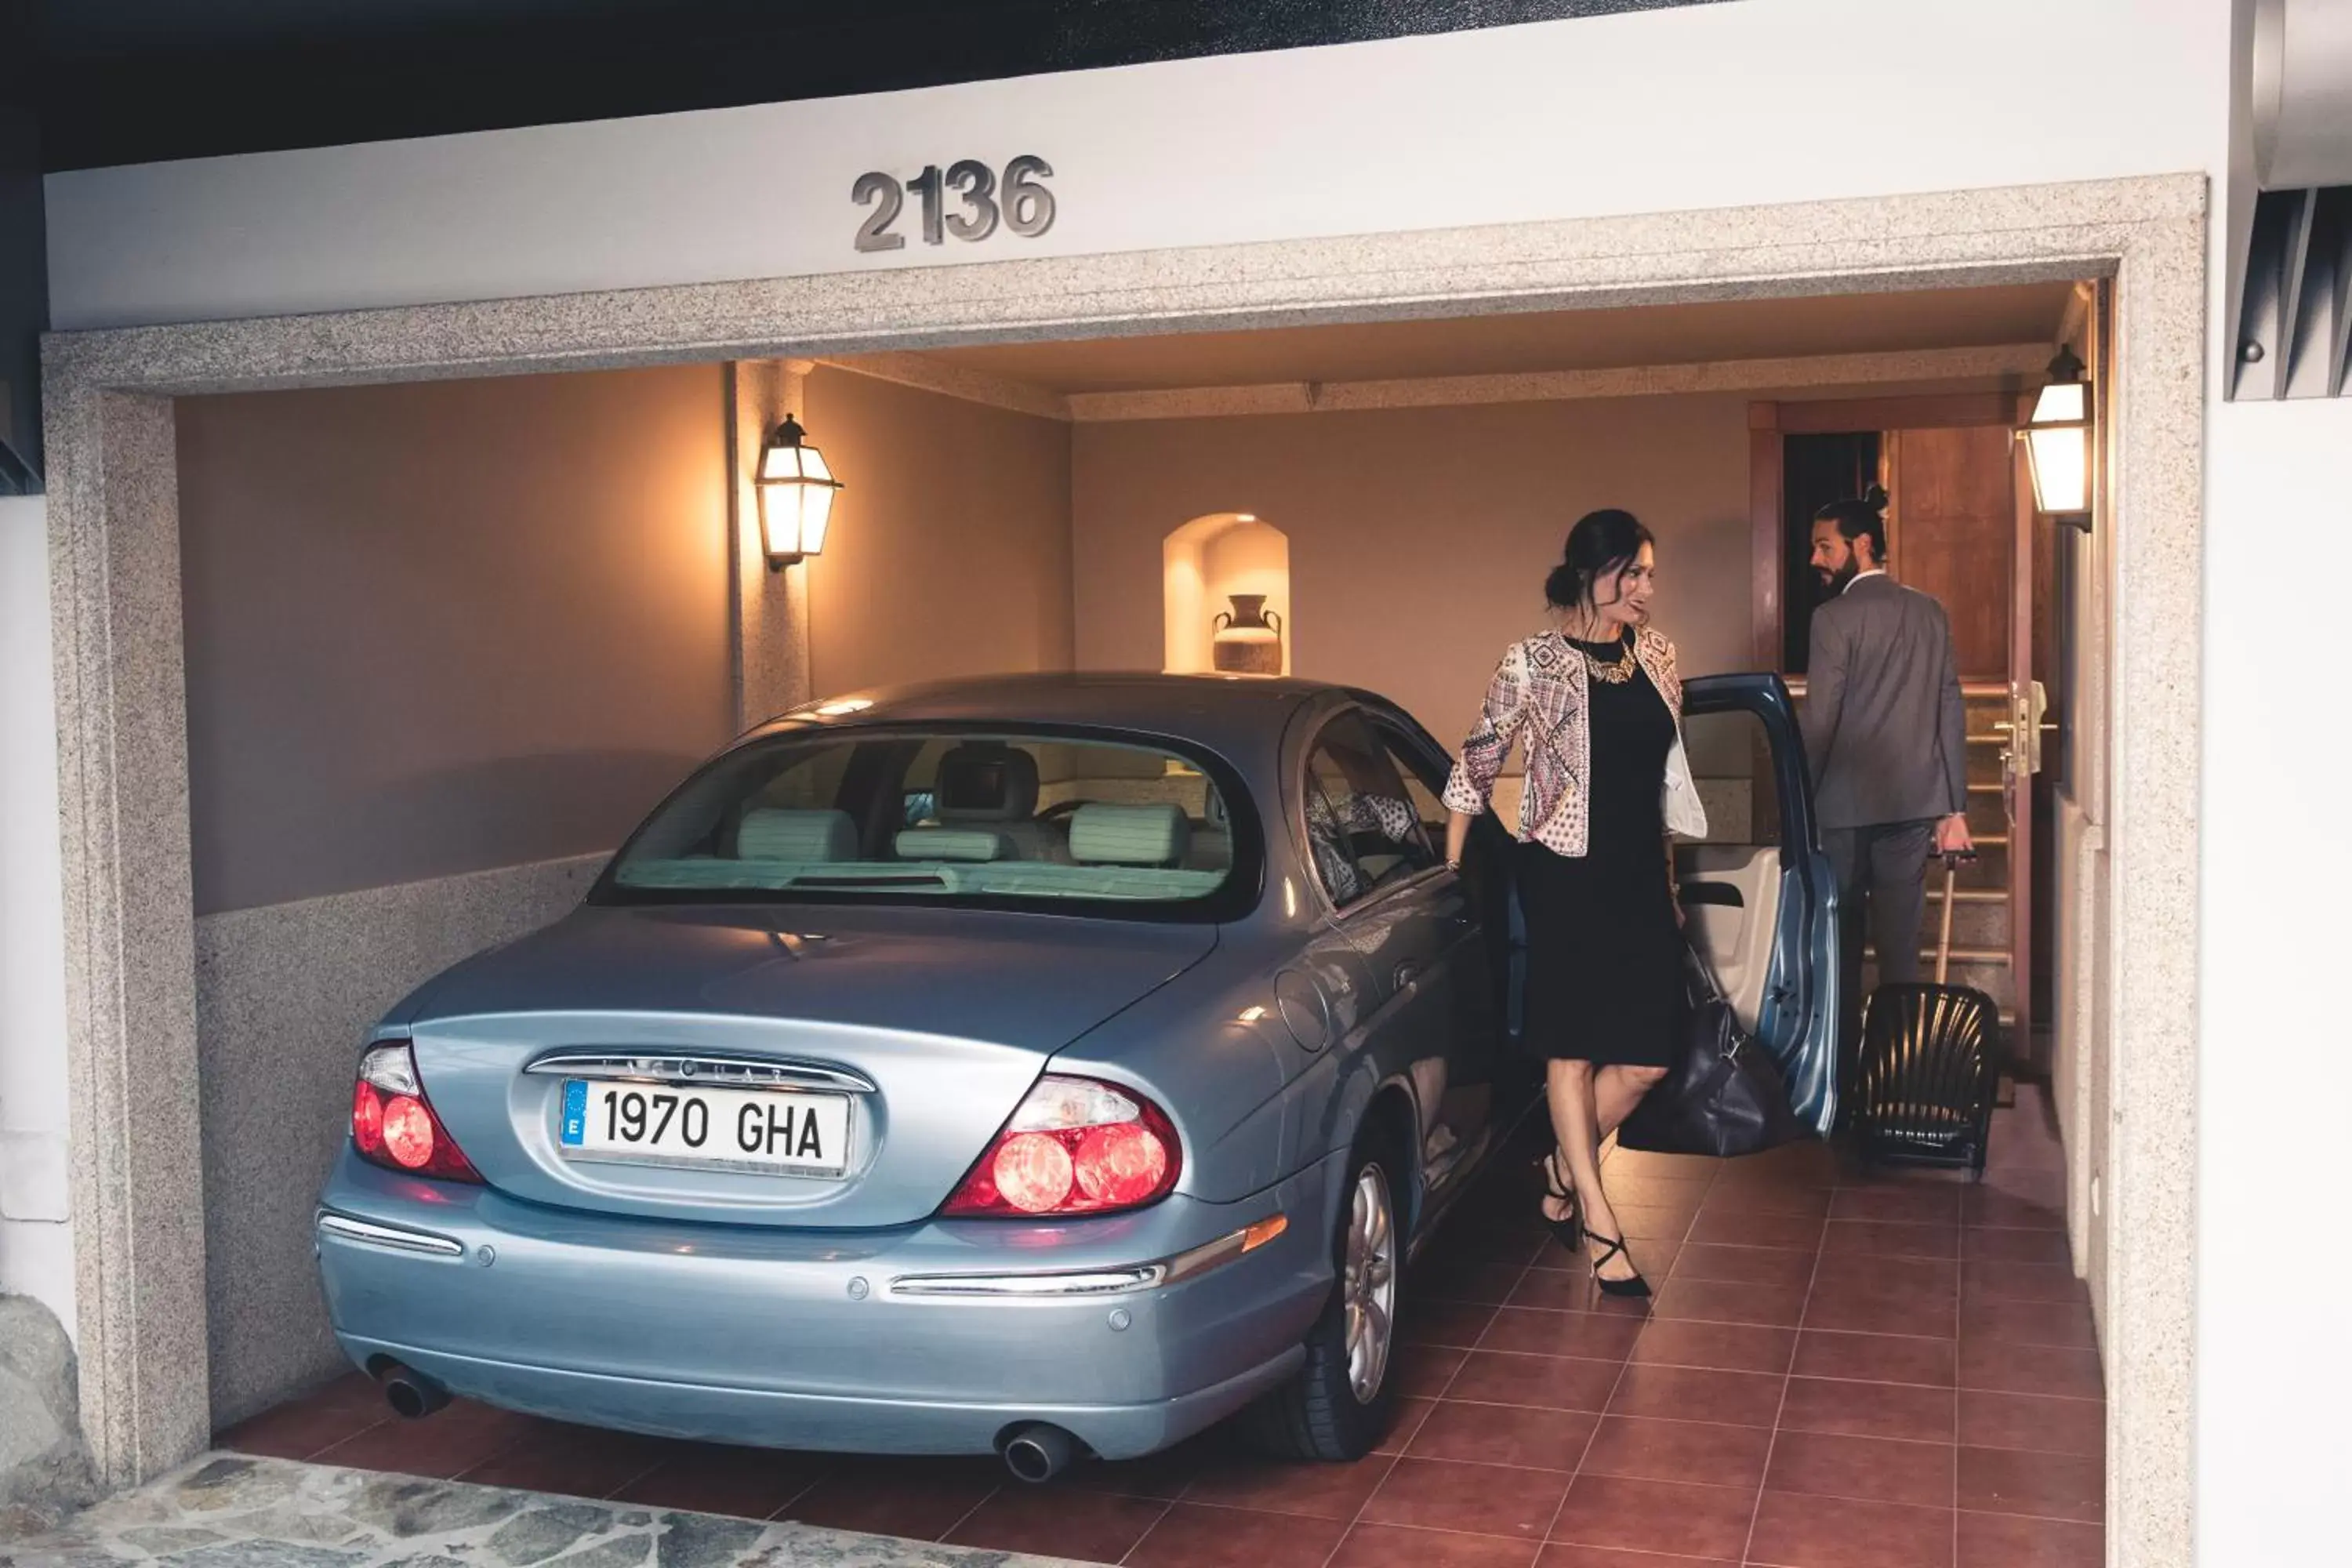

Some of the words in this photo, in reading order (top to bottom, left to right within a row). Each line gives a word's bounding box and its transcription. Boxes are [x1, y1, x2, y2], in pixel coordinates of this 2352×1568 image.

[851, 154, 1056, 252] 2136
[568, 1120, 579, 1134] E
[604, 1091, 709, 1148] 1970
[737, 1102, 822, 1159] GHA
